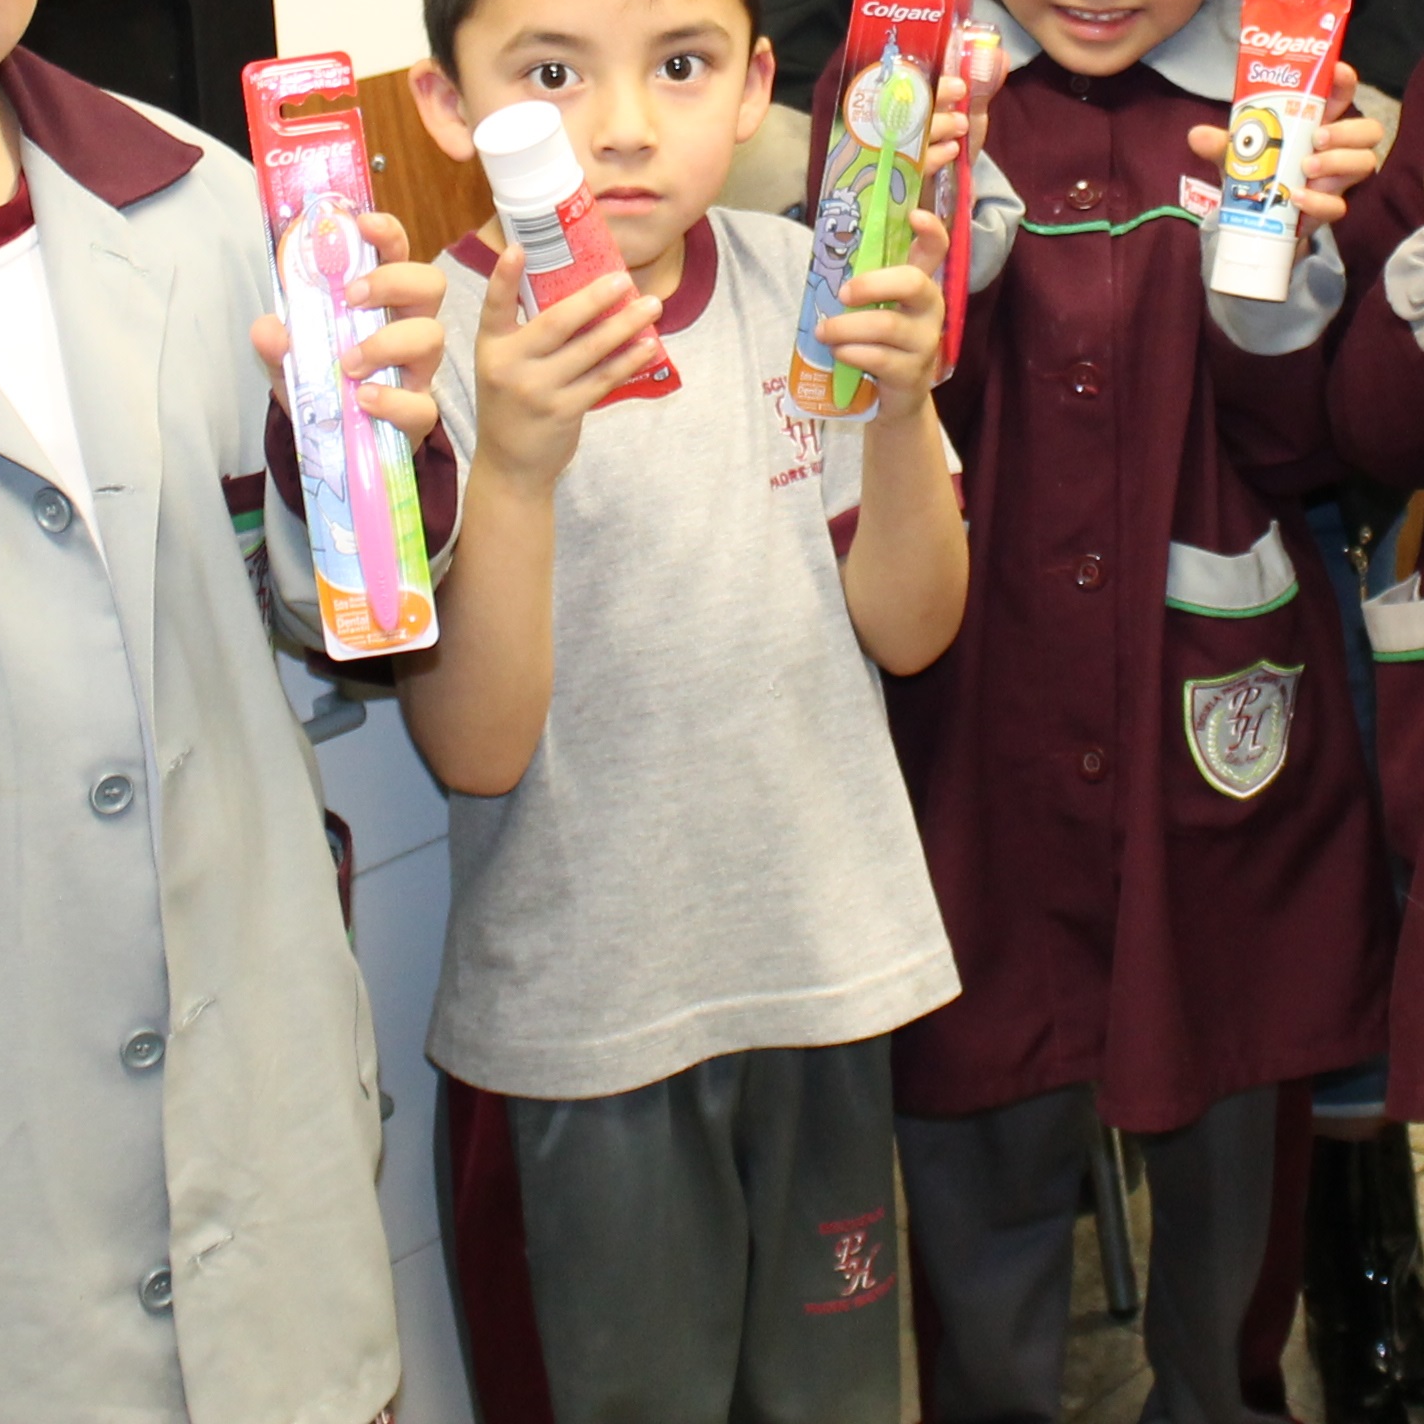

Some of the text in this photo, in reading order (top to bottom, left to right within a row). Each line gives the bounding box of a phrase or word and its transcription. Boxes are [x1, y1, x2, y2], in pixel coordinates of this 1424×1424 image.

[861, 1, 943, 23] Colgate
[1240, 25, 1330, 57] Colgate
[1249, 61, 1300, 87] Smiles
[265, 142, 353, 168] Colgate
